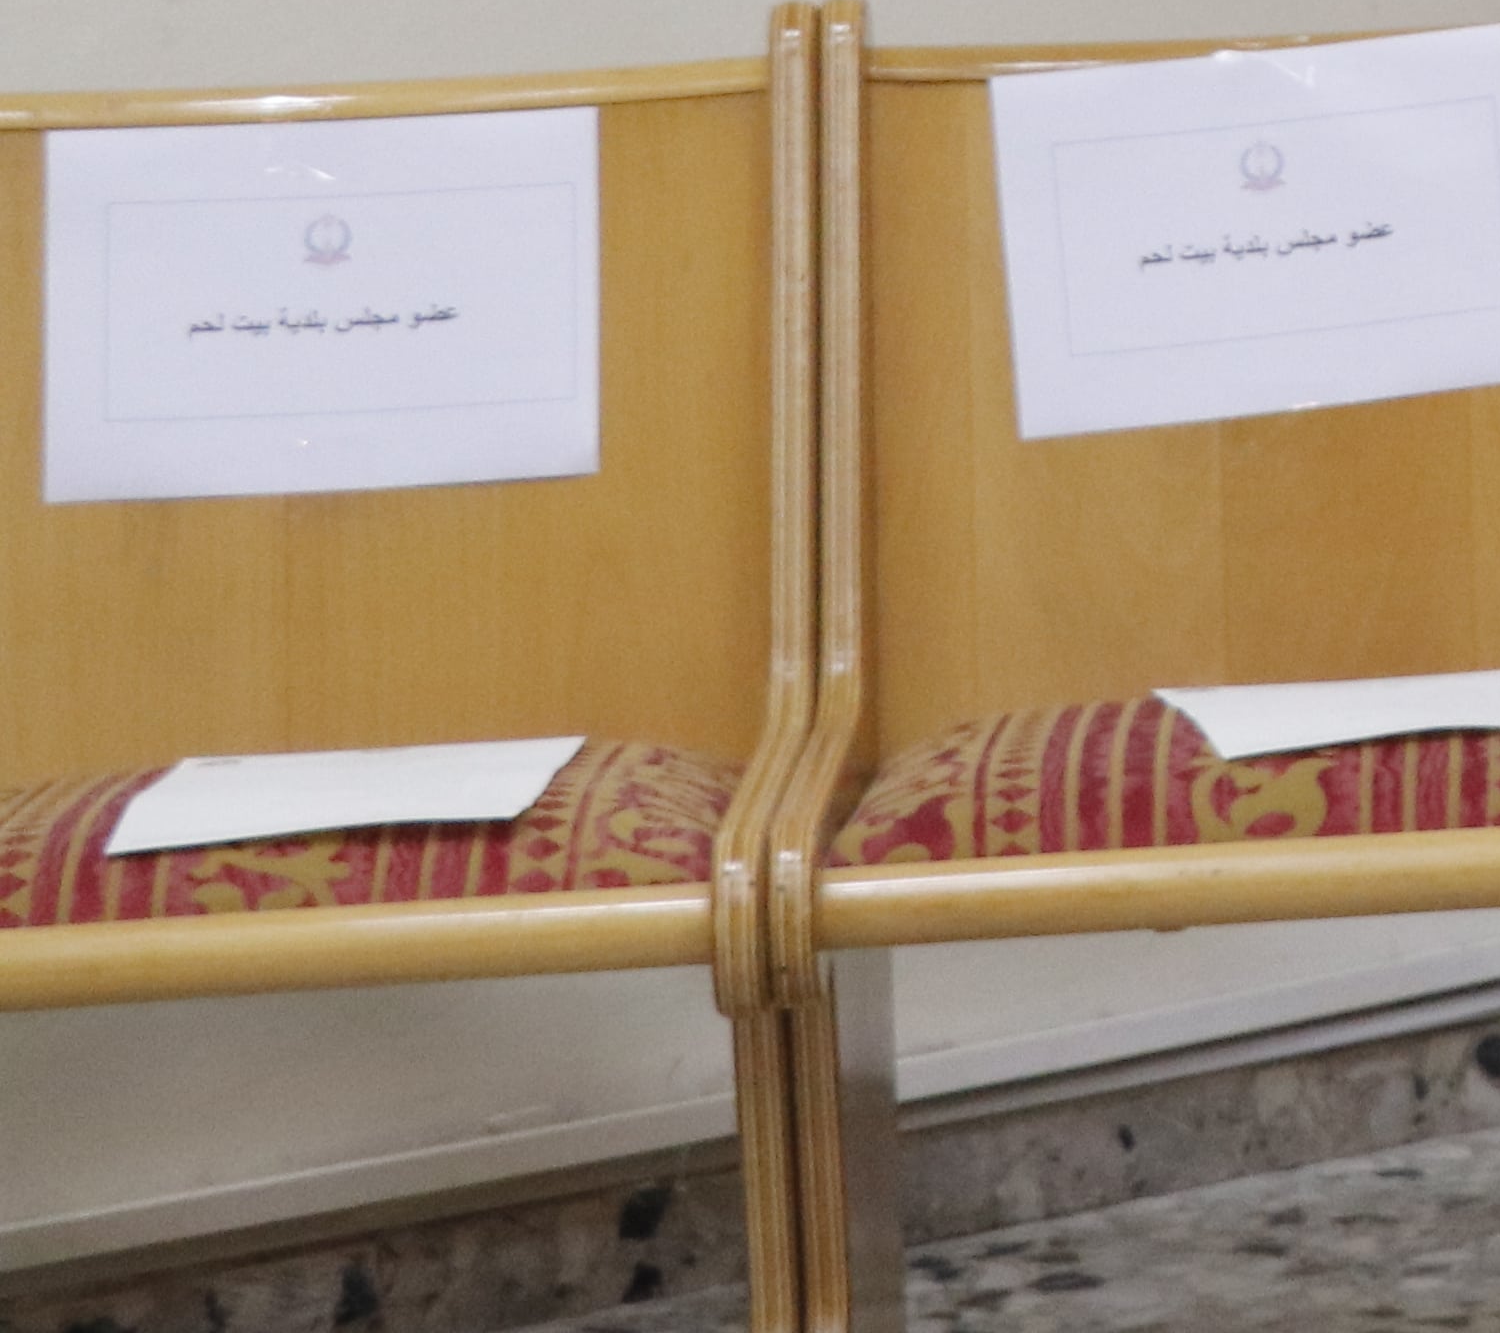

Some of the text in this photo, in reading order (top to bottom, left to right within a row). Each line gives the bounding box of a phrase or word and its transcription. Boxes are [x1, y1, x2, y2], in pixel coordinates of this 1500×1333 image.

[1140, 222, 1393, 270] عضو مجلس بلدية بيت لحم
[189, 304, 458, 341] عضو مجلس بلدية بيت لحم
